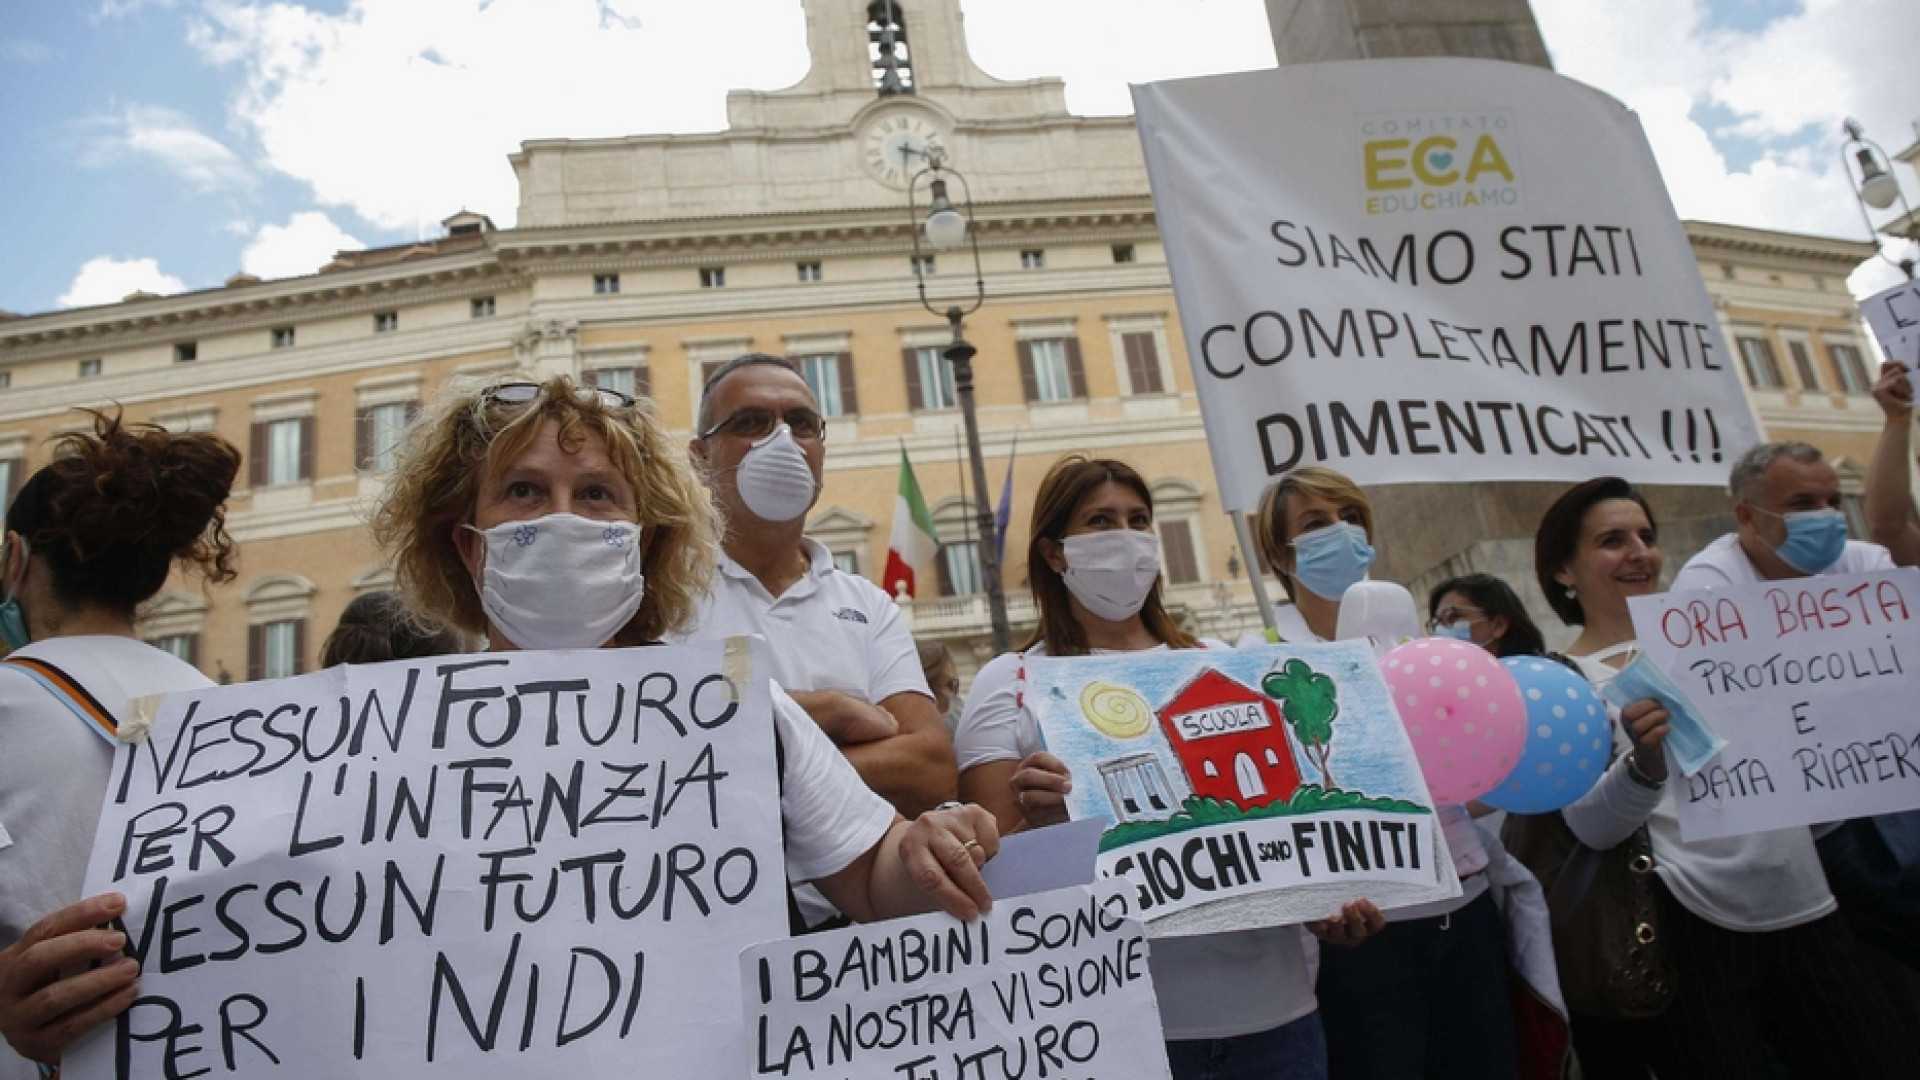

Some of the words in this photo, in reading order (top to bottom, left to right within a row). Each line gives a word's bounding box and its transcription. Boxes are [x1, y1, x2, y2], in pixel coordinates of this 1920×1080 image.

[1361, 116, 1508, 135] COMITATO
[1364, 133, 1514, 190] ECA
[1367, 187, 1518, 215] EDUCHIAMO
[1270, 220, 1475, 286] SIAMO
[1500, 225, 1642, 280] STATI
[1200, 307, 1723, 380] COMPLETAMENTE
[1255, 400, 1651, 477] DIMENTICATI
[1662, 598, 1747, 648] ORA
[1764, 580, 1910, 638] BASTA
[114, 667, 420, 804] NESSUN
[432, 659, 739, 750] FUTURO
[1181, 704, 1264, 737] SCUOLA
[1792, 701, 1815, 735] E
[1681, 758, 1775, 802] DATA
[112, 800, 236, 882] PER
[1291, 820, 1421, 877] FINITI
[91, 853, 444, 978] NESSUN
[479, 843, 758, 932] FUTURO
[759, 957, 771, 1004] I
[794, 920, 988, 1002] BAMBINI
[1004, 893, 1129, 955] SONO
[115, 993, 280, 1080] PER
[355, 976, 364, 1060] I
[426, 932, 645, 1063] NIDI
[758, 1014, 814, 1076] LA
[827, 987, 976, 1066] NOSTRA
[992, 936, 1143, 1025] VISIONE
